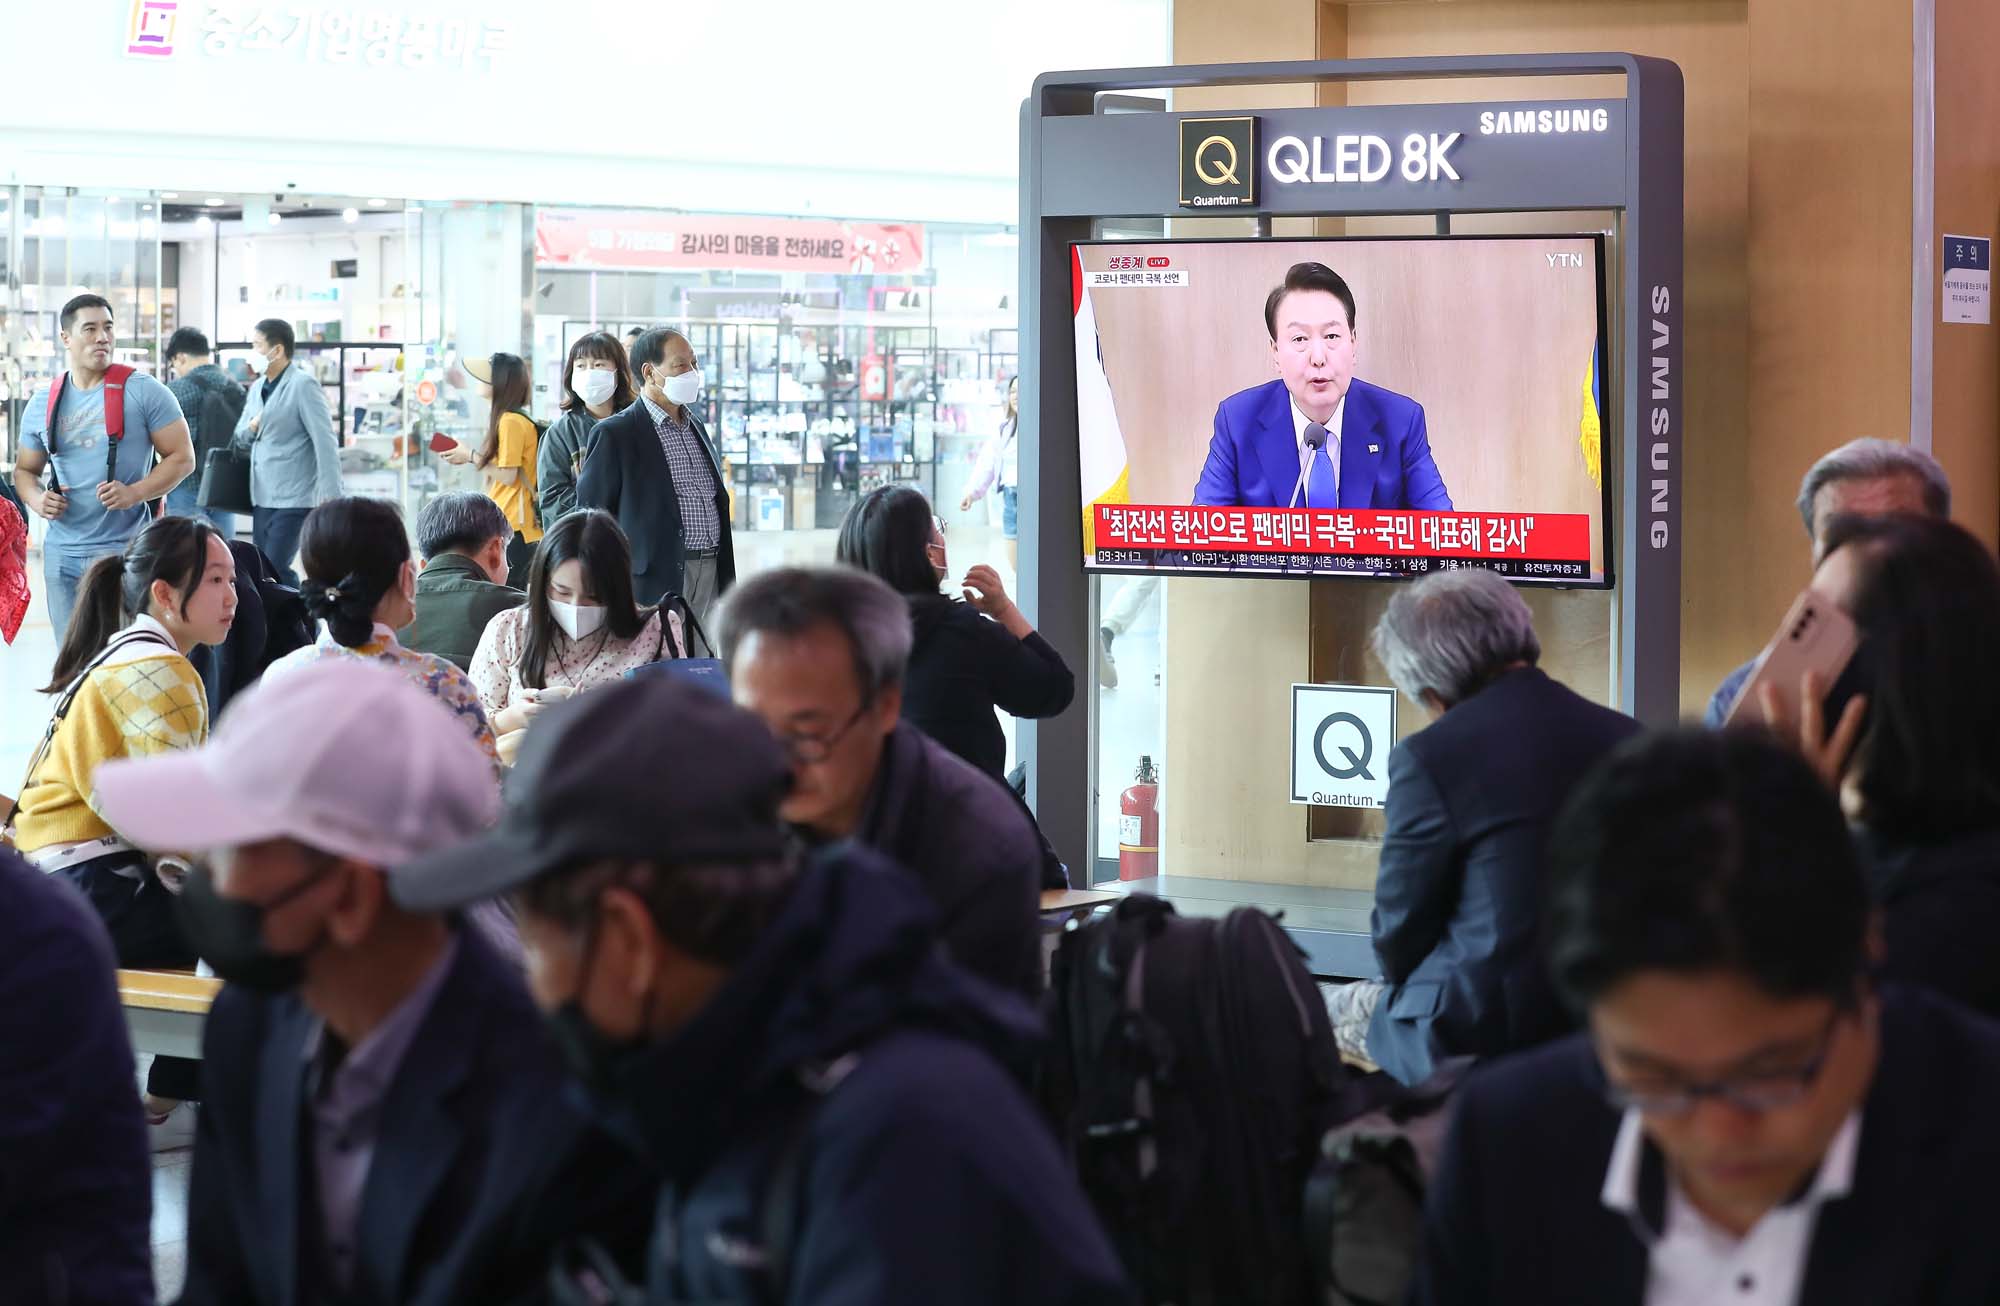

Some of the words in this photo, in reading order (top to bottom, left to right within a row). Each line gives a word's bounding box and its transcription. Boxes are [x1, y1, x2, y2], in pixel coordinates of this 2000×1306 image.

[1480, 109, 1608, 135] SAMSUNG
[1267, 135, 1393, 184] QLED
[1401, 132, 1461, 182] 8K
[1193, 195, 1239, 206] Quantum
[682, 233, 729, 254] 감사의
[735, 235, 779, 257] 마음을
[785, 237, 845, 259] 전하세요
[1109, 256, 1144, 269] 생중계
[1546, 253, 1583, 267] YTN
[1094, 274, 1118, 284] 코로나
[1119, 274, 1144, 284] 팬데믹
[1145, 274, 1161, 284] 극복
[1163, 274, 1180, 284] 선언
[1651, 285, 1670, 549] SAMSUNG
[1102, 508, 1166, 543] "최전선
[1171, 510, 1249, 544] 헌신으로
[1252, 512, 1311, 548] 팬데믹
[1421, 516, 1481, 552] 대표해
[1486, 517, 1534, 553] 감사"
[1098, 550, 1126, 562] 09:34
[1192, 552, 1217, 565] [야구]
[1218, 553, 1248, 566] '노시환
[1250, 554, 1289, 567] 연타석포'
[1291, 555, 1312, 568] 한화,
[1313, 556, 1332, 569] 시즌
[1409, 559, 1428, 571] 삼성
[1440, 560, 1459, 572] 키움
[1524, 563, 1582, 574] 유진투자증권
[1312, 791, 1373, 807] Quantum
